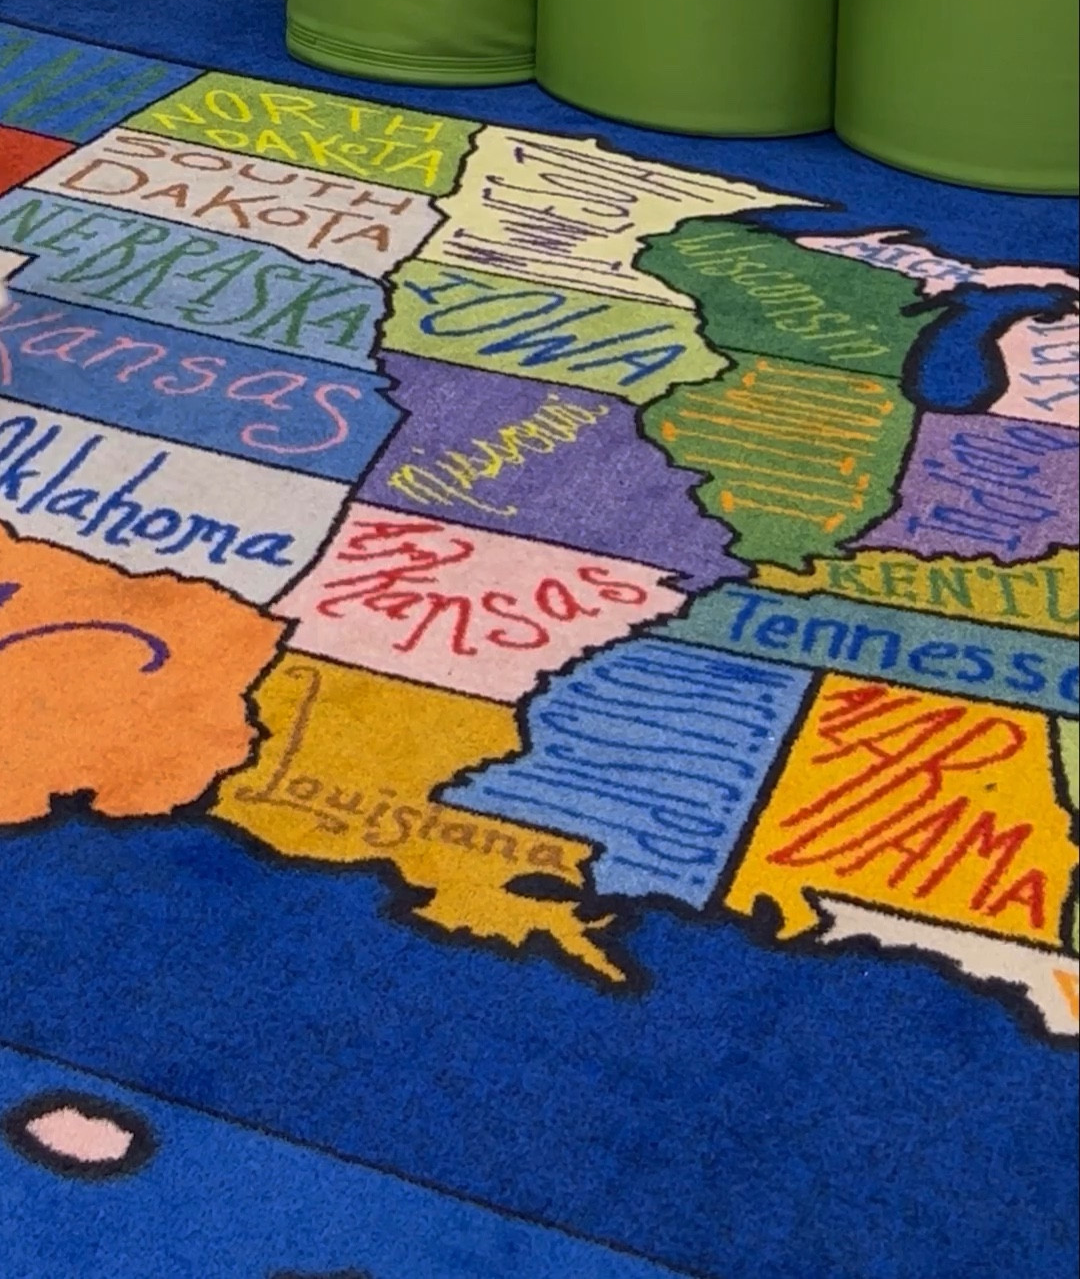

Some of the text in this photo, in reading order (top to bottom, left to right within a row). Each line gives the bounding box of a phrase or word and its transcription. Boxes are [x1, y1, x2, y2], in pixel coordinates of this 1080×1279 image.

[151, 90, 443, 142] NORTH
[205, 129, 443, 187] DAKOTA
[60, 159, 390, 252] DAKOTA
[104, 136, 413, 216] SOUTH
[672, 231, 890, 361] Wisconsin
[823, 241, 984, 284] MICH
[403, 272, 686, 386] IOWA
[234, 666, 576, 873] Louisiana
[766, 683, 1046, 930] ALABAMA
